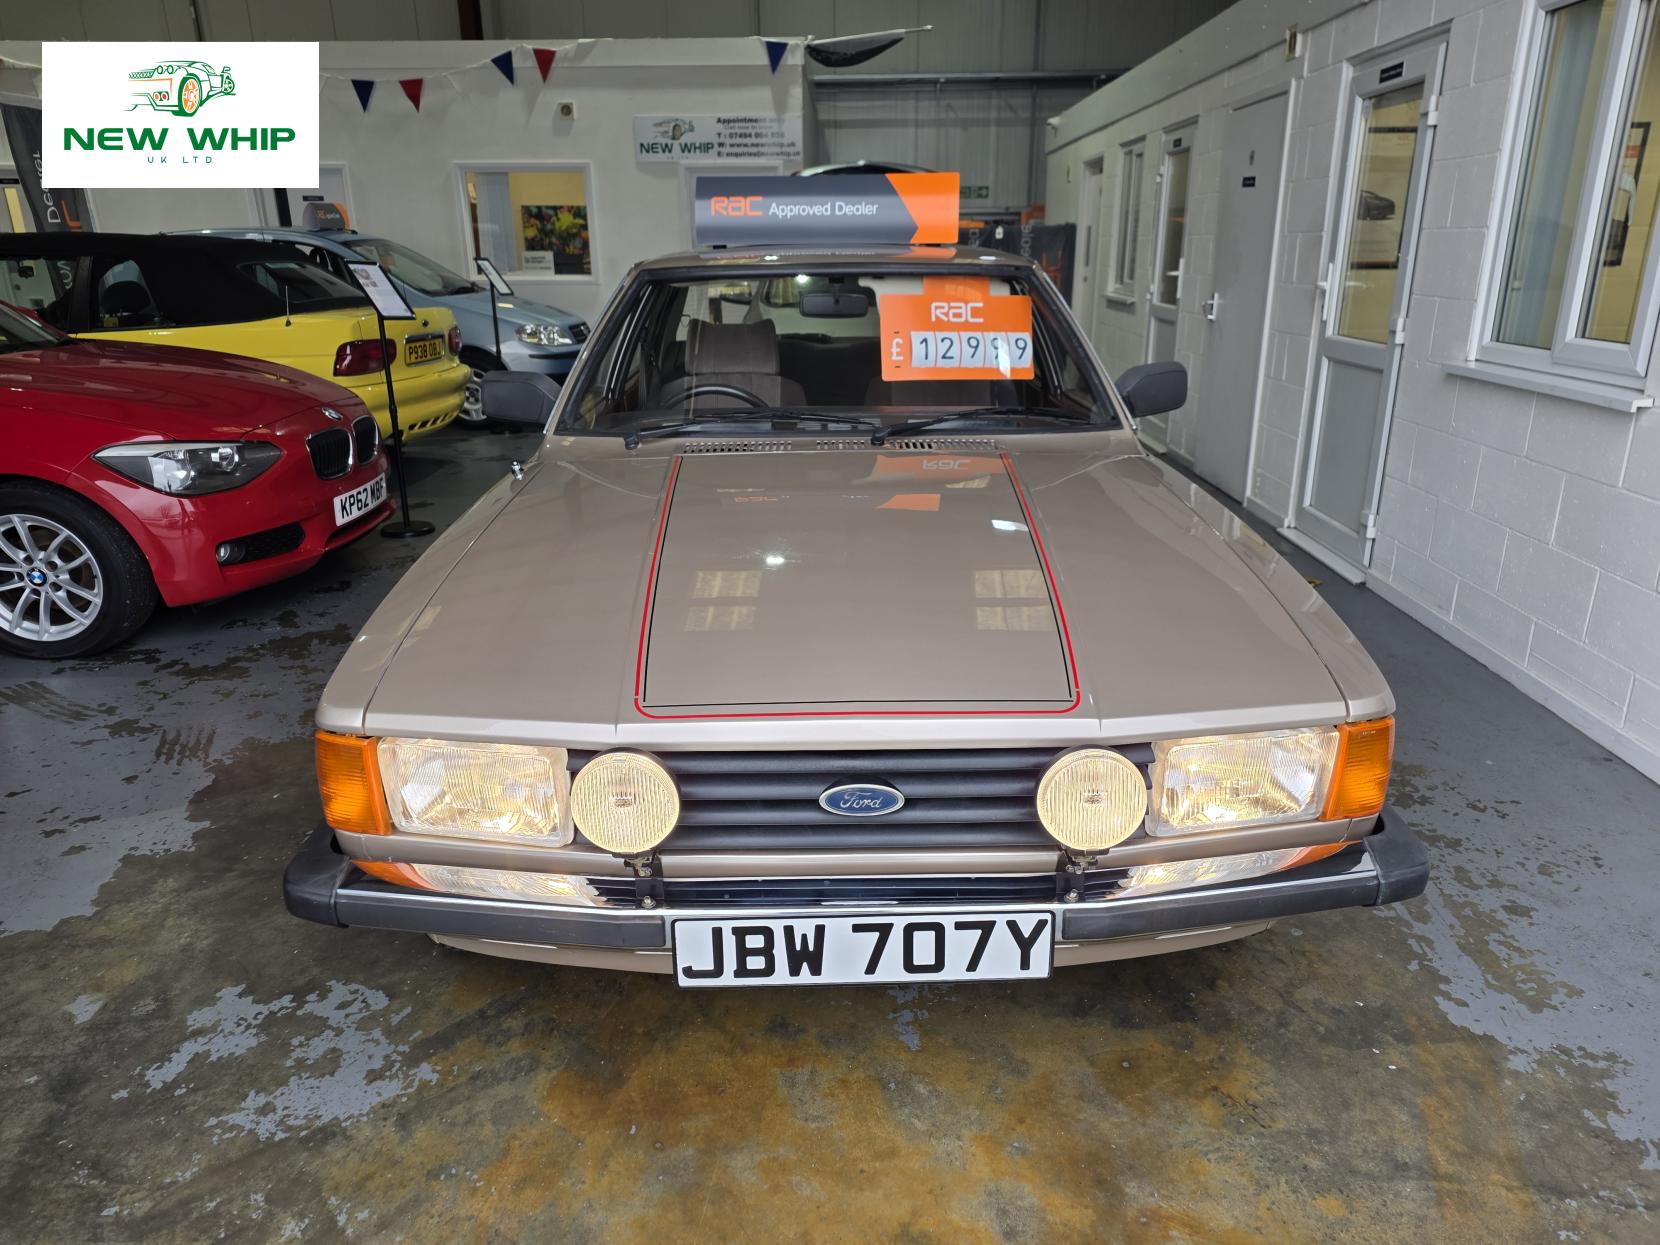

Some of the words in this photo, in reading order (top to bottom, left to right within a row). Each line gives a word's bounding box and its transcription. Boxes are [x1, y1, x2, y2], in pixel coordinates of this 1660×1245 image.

[639, 142, 673, 154] NEW
[680, 142, 715, 154] WHIP
[711, 196, 763, 217] RAC
[769, 201, 831, 219] Approved
[835, 201, 879, 216] Dealer
[930, 302, 984, 323] RAC
[408, 343, 428, 361] P938
[340, 488, 369, 519] KP62
[370, 477, 384, 504] MBF
[839, 790, 884, 809] Ford
[682, 924, 826, 979] JBW
[851, 919, 1049, 975] 707Y
